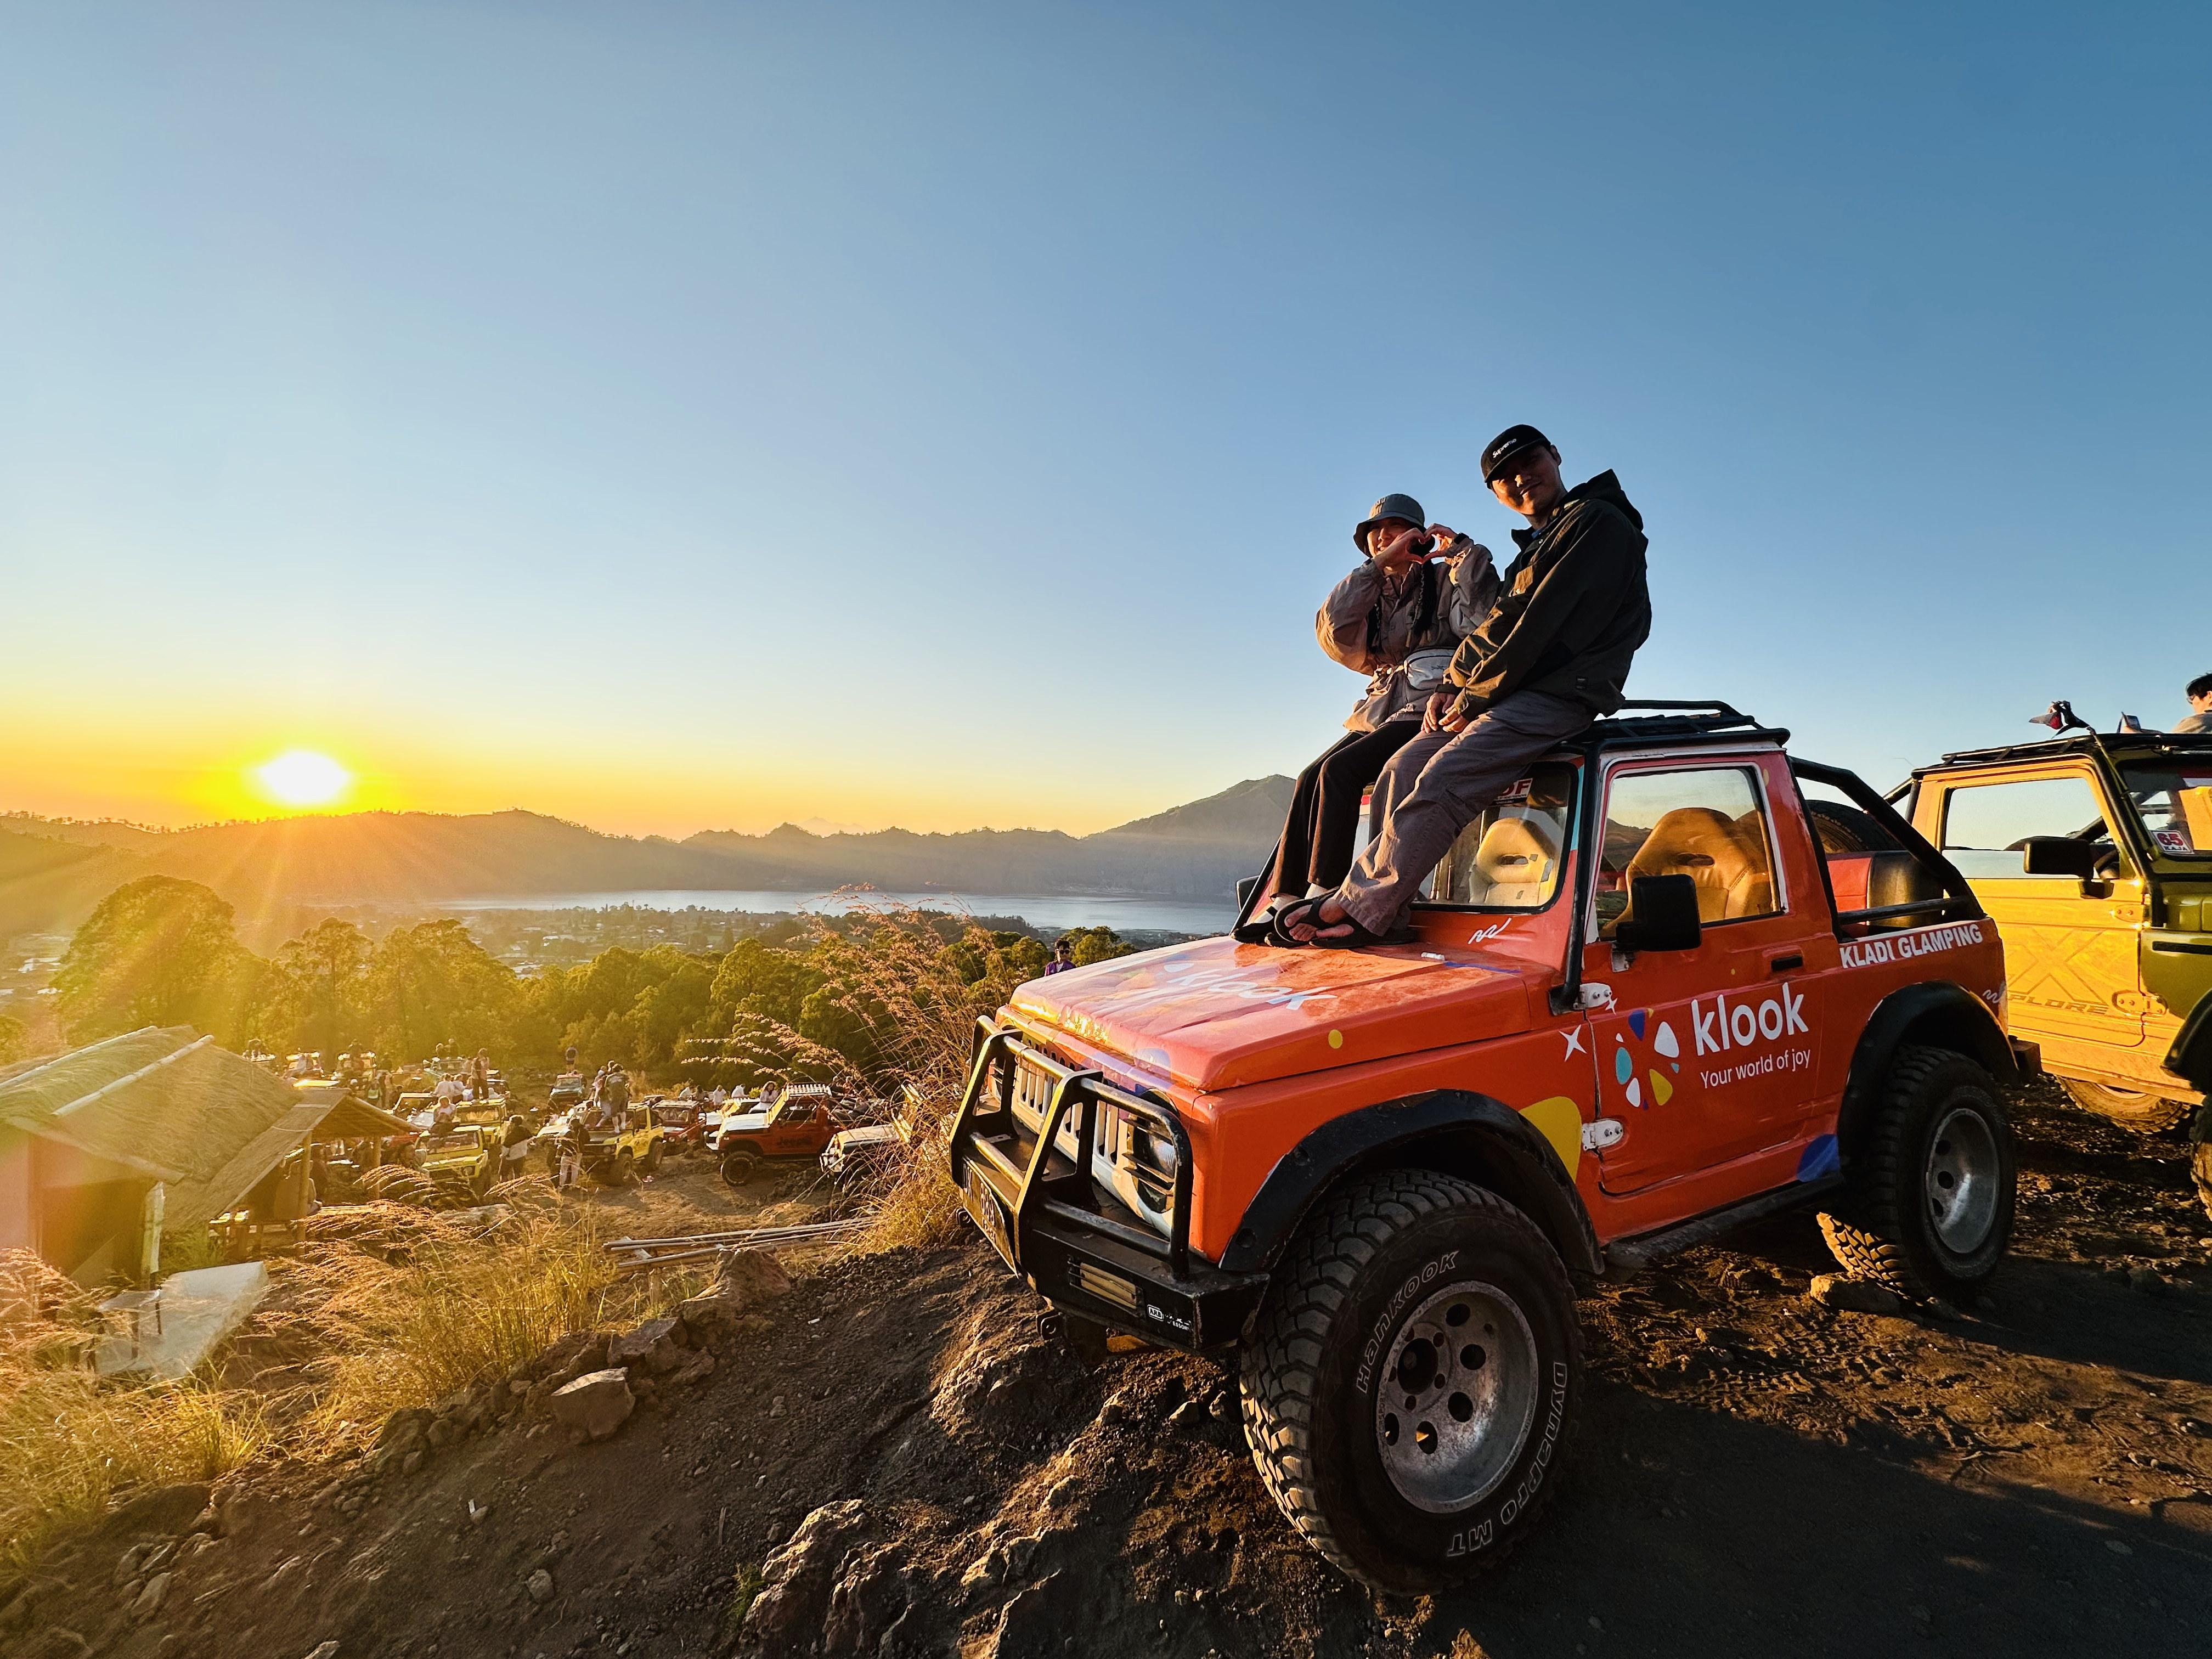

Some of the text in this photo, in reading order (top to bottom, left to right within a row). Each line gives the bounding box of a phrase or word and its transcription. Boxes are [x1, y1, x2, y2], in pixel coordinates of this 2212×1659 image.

[2157, 833, 2183, 846] 65
[1839, 924, 1983, 968] KLADI GLAMPING
[1166, 969, 1338, 1010] klook
[1691, 982, 1809, 1056] klook
[1700, 1048, 1810, 1088] Your world of joy
[1149, 1307, 1162, 1319] ARB
[1447, 1519, 1492, 1557] MT
